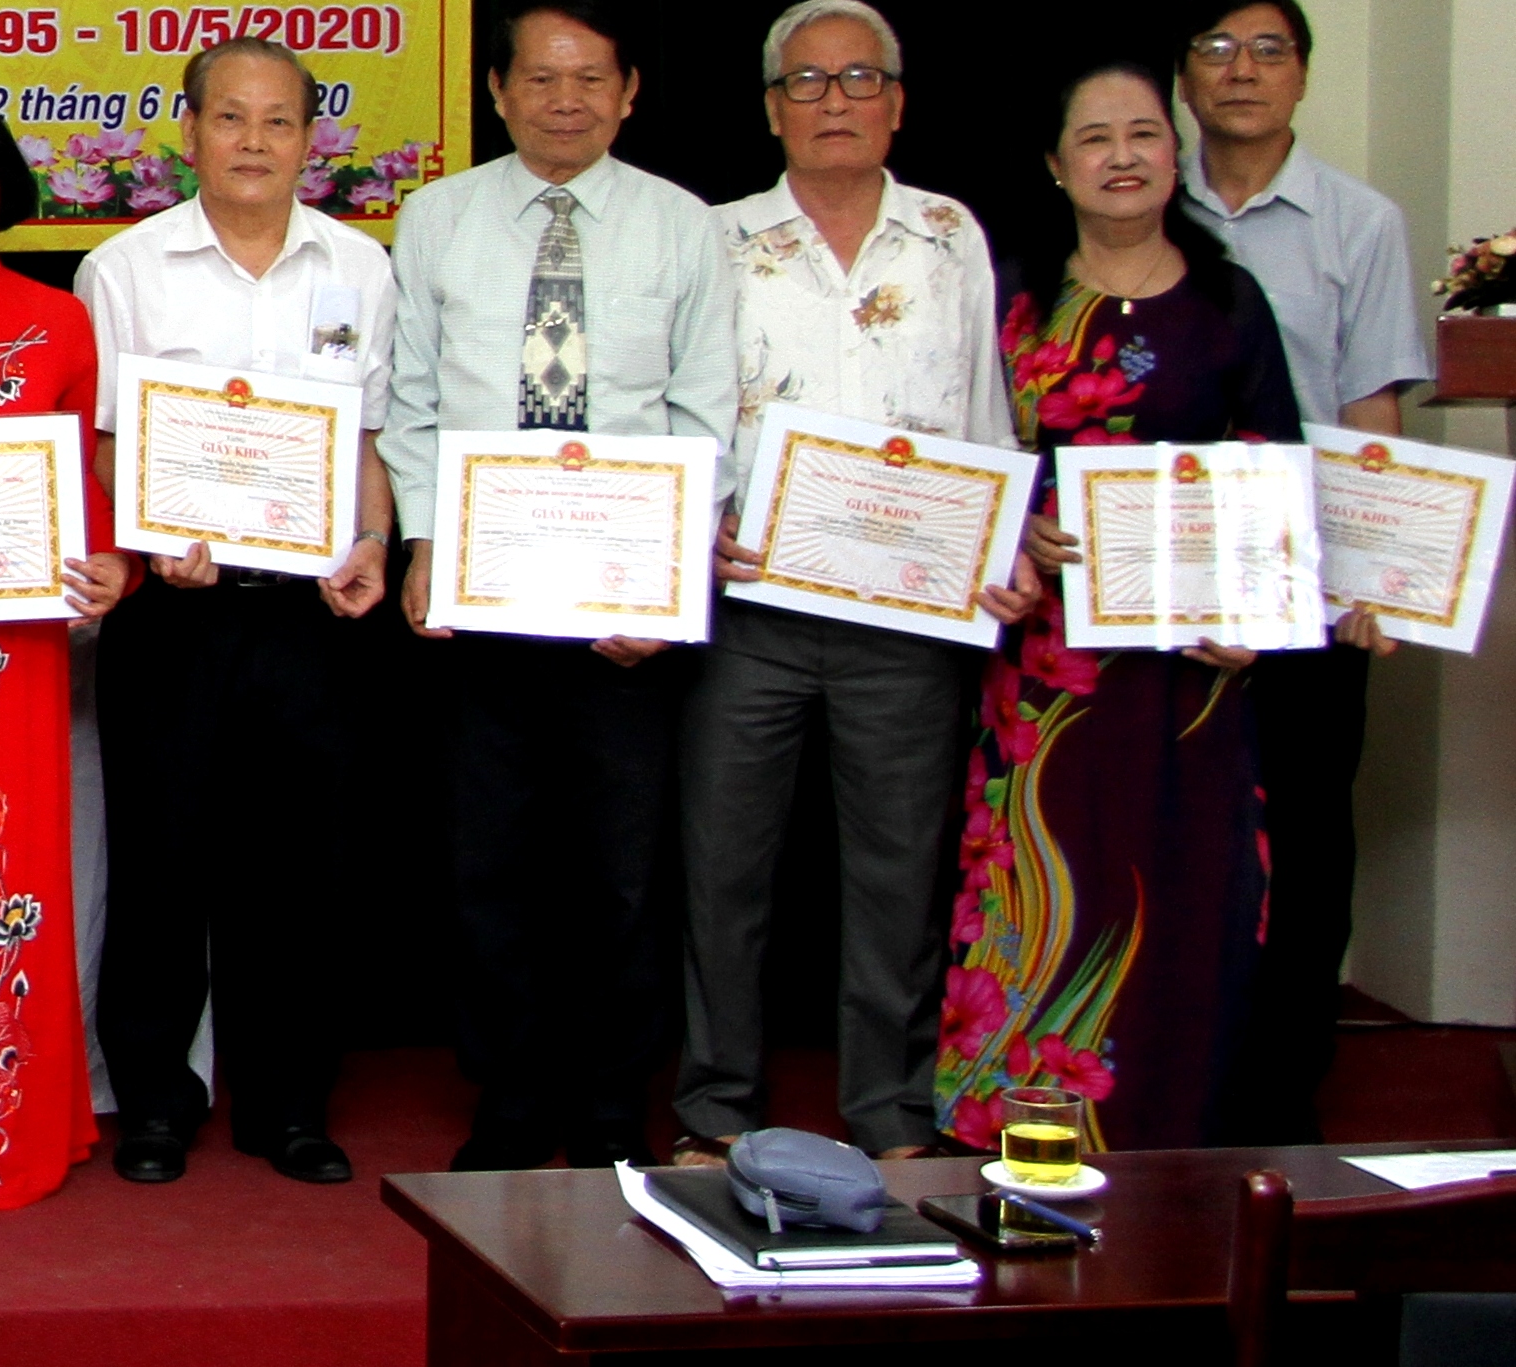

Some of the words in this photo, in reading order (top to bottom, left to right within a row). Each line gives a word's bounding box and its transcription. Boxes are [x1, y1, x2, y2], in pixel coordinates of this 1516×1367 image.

[20, 86, 127, 130] tháng
[139, 85, 161, 120] 6
[235, 445, 269, 460] KHEN
